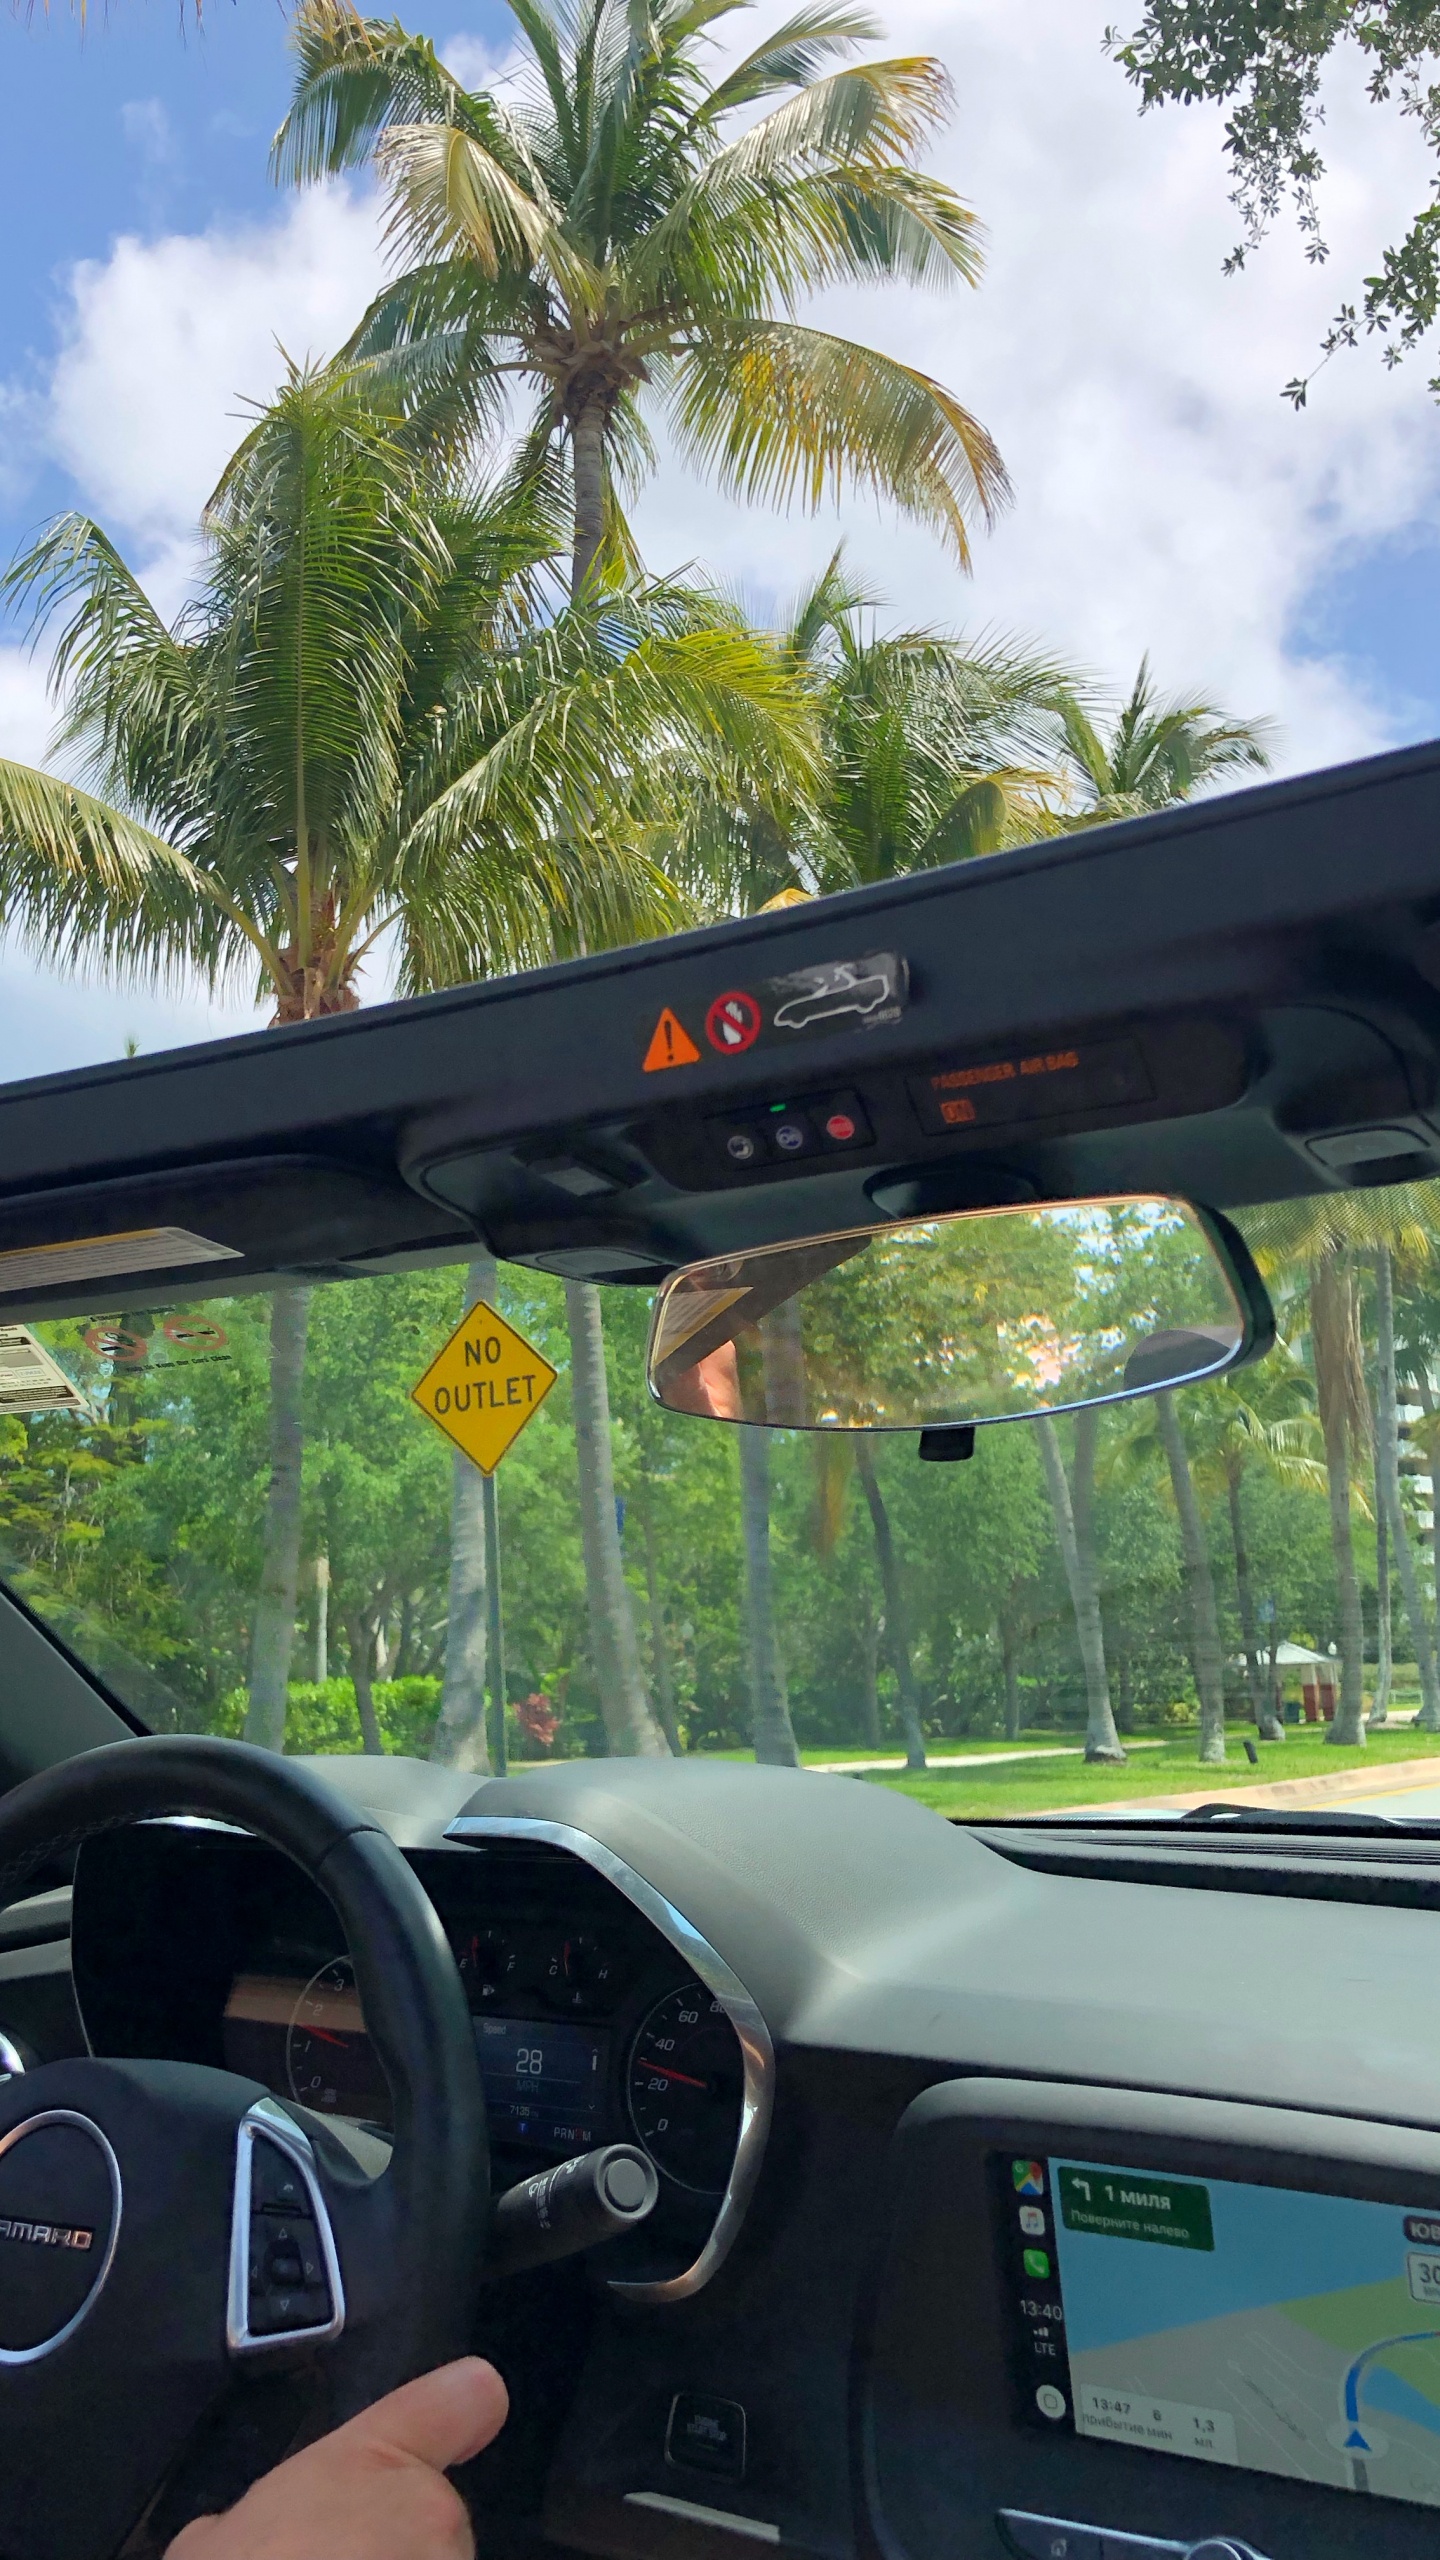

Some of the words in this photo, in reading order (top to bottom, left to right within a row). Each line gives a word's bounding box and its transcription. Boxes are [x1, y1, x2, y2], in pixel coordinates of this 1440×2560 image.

[931, 1062, 1016, 1090] PASSENGER
[464, 1336, 501, 1367] NO
[434, 1374, 536, 1415] OUTLET
[459, 1958, 468, 1969] E
[506, 1961, 515, 1972] F
[549, 1965, 558, 1976] C
[598, 1969, 608, 1979] H
[334, 1979, 345, 1992] 3
[313, 2004, 323, 2016] 2
[678, 2010, 699, 2024] 60
[304, 2039, 312, 2053] 1
[655, 2039, 675, 2051] 40
[515, 2048, 543, 2075] 28
[310, 2076, 321, 2088] 0
[647, 2077, 668, 2091] 20
[657, 2118, 668, 2131] 0
[1104, 2185, 1114, 2201] 1
[1120, 2190, 1171, 2210] миля
[1070, 2208, 1140, 2231] Поверните
[1144, 2223, 1190, 2239] налево
[1020, 2299, 1063, 2321] 13:40
[1034, 2341, 1056, 2356] LTE
[1092, 2397, 1131, 2415] 13:47
